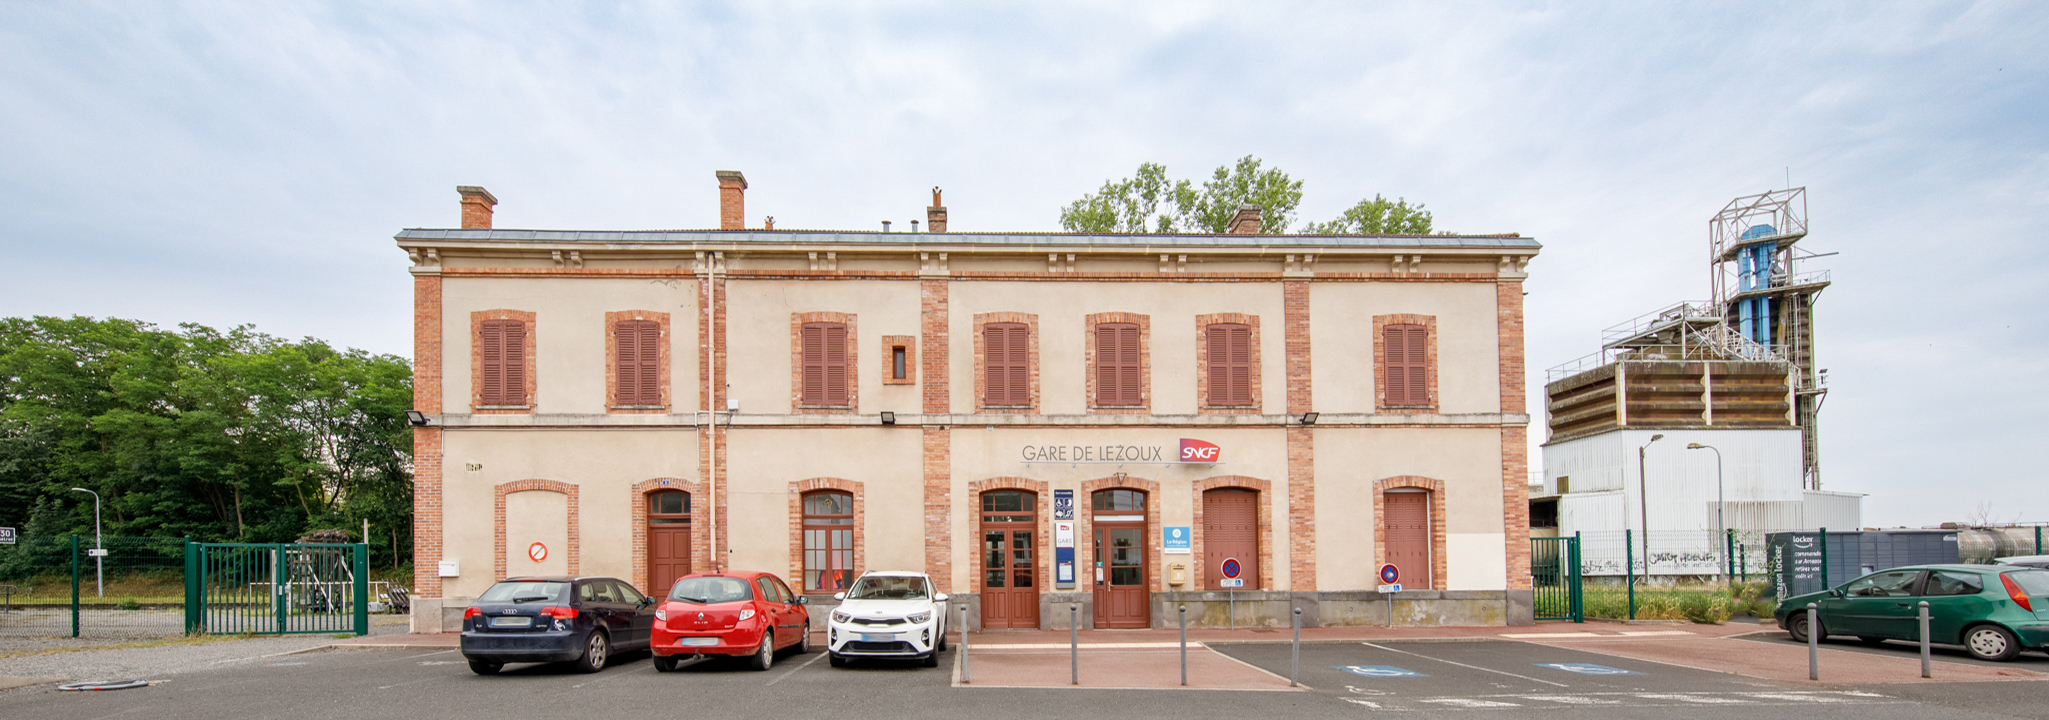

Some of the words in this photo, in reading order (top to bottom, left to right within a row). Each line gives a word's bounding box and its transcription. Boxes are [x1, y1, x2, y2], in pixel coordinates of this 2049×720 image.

[1022, 445, 1066, 461] GARE
[1073, 446, 1093, 461] DE
[1100, 446, 1162, 461] LEZOUX
[1182, 447, 1218, 459] SNCF
[1774, 545, 1782, 572] locker
